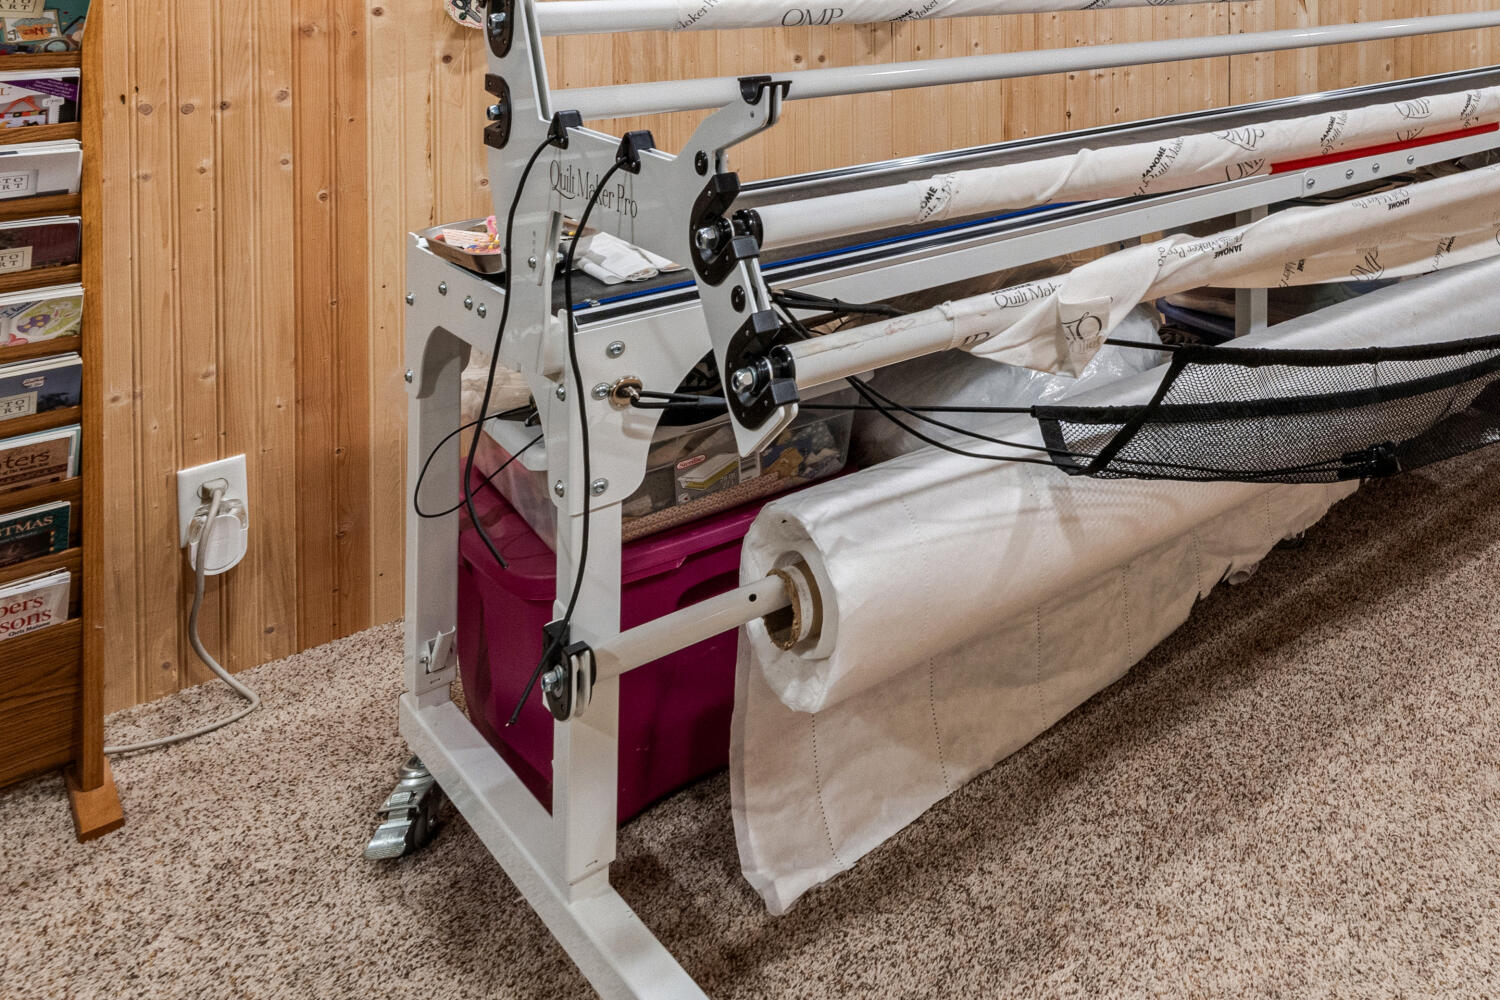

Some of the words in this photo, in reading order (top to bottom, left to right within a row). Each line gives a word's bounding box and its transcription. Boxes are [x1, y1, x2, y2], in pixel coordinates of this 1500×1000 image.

[1142, 146, 1167, 178] JANOME
[549, 159, 576, 200] Quilt
[616, 183, 638, 218] Pro
[1388, 197, 1411, 210] JANOME
[1213, 244, 1243, 259] JANOME
[994, 287, 1030, 309] Quilt
